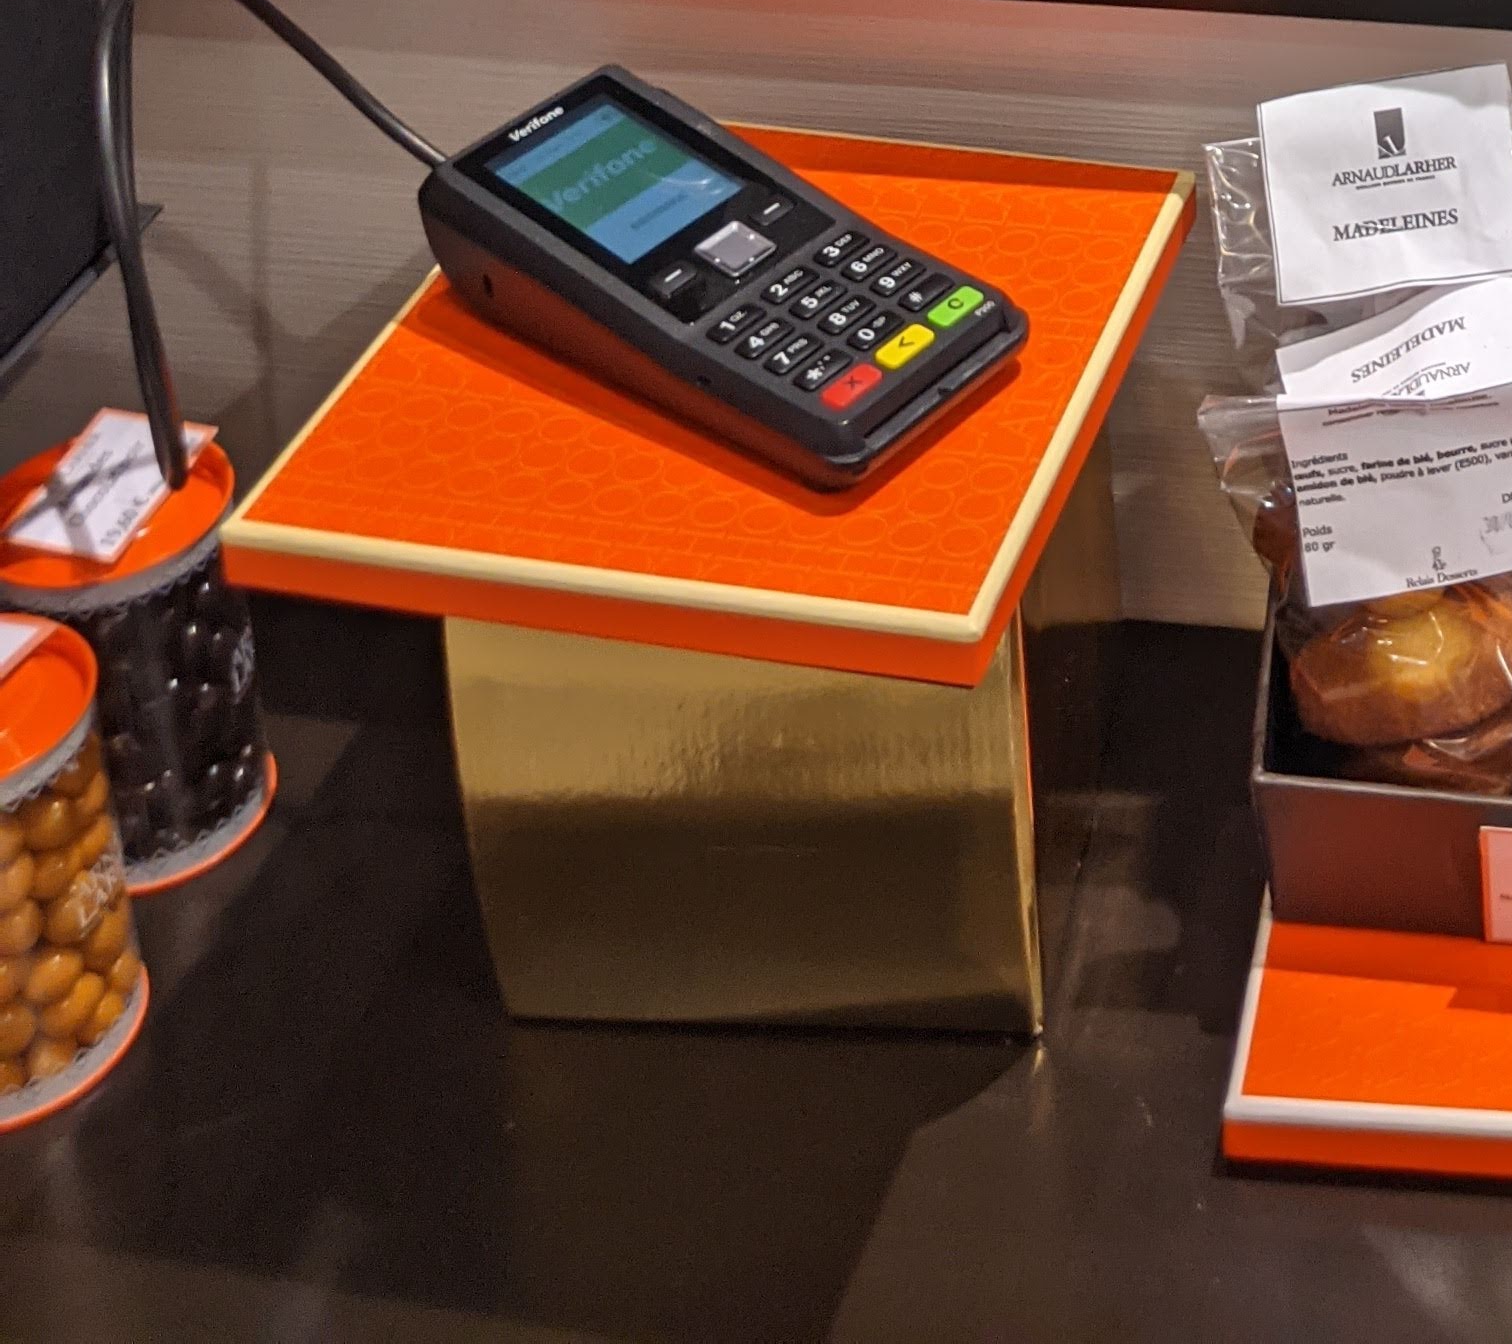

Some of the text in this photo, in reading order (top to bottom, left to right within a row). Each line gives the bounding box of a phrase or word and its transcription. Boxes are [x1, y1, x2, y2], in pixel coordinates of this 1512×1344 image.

[508, 106, 565, 142] Verifone
[1332, 209, 1459, 242] MADELEINES
[823, 245, 840, 258] 3
[850, 261, 867, 273] 6
[770, 283, 788, 296] 2
[878, 276, 896, 289] 9
[800, 296, 818, 309] 5
[719, 320, 736, 331] 1
[828, 312, 847, 326] 8
[857, 328, 875, 341] 0
[749, 335, 765, 349] 4
[1350, 316, 1467, 384] MADELEINES
[773, 351, 791, 365] 7
[1396, 457, 1411, 467] de
[1480, 439, 1508, 451] sucre
[1340, 477, 1355, 488] de
[1380, 469, 1416, 484] poudre
[1302, 525, 1333, 538] Poids
[1322, 539, 1336, 553] gr
[1405, 571, 1436, 589] Relais
